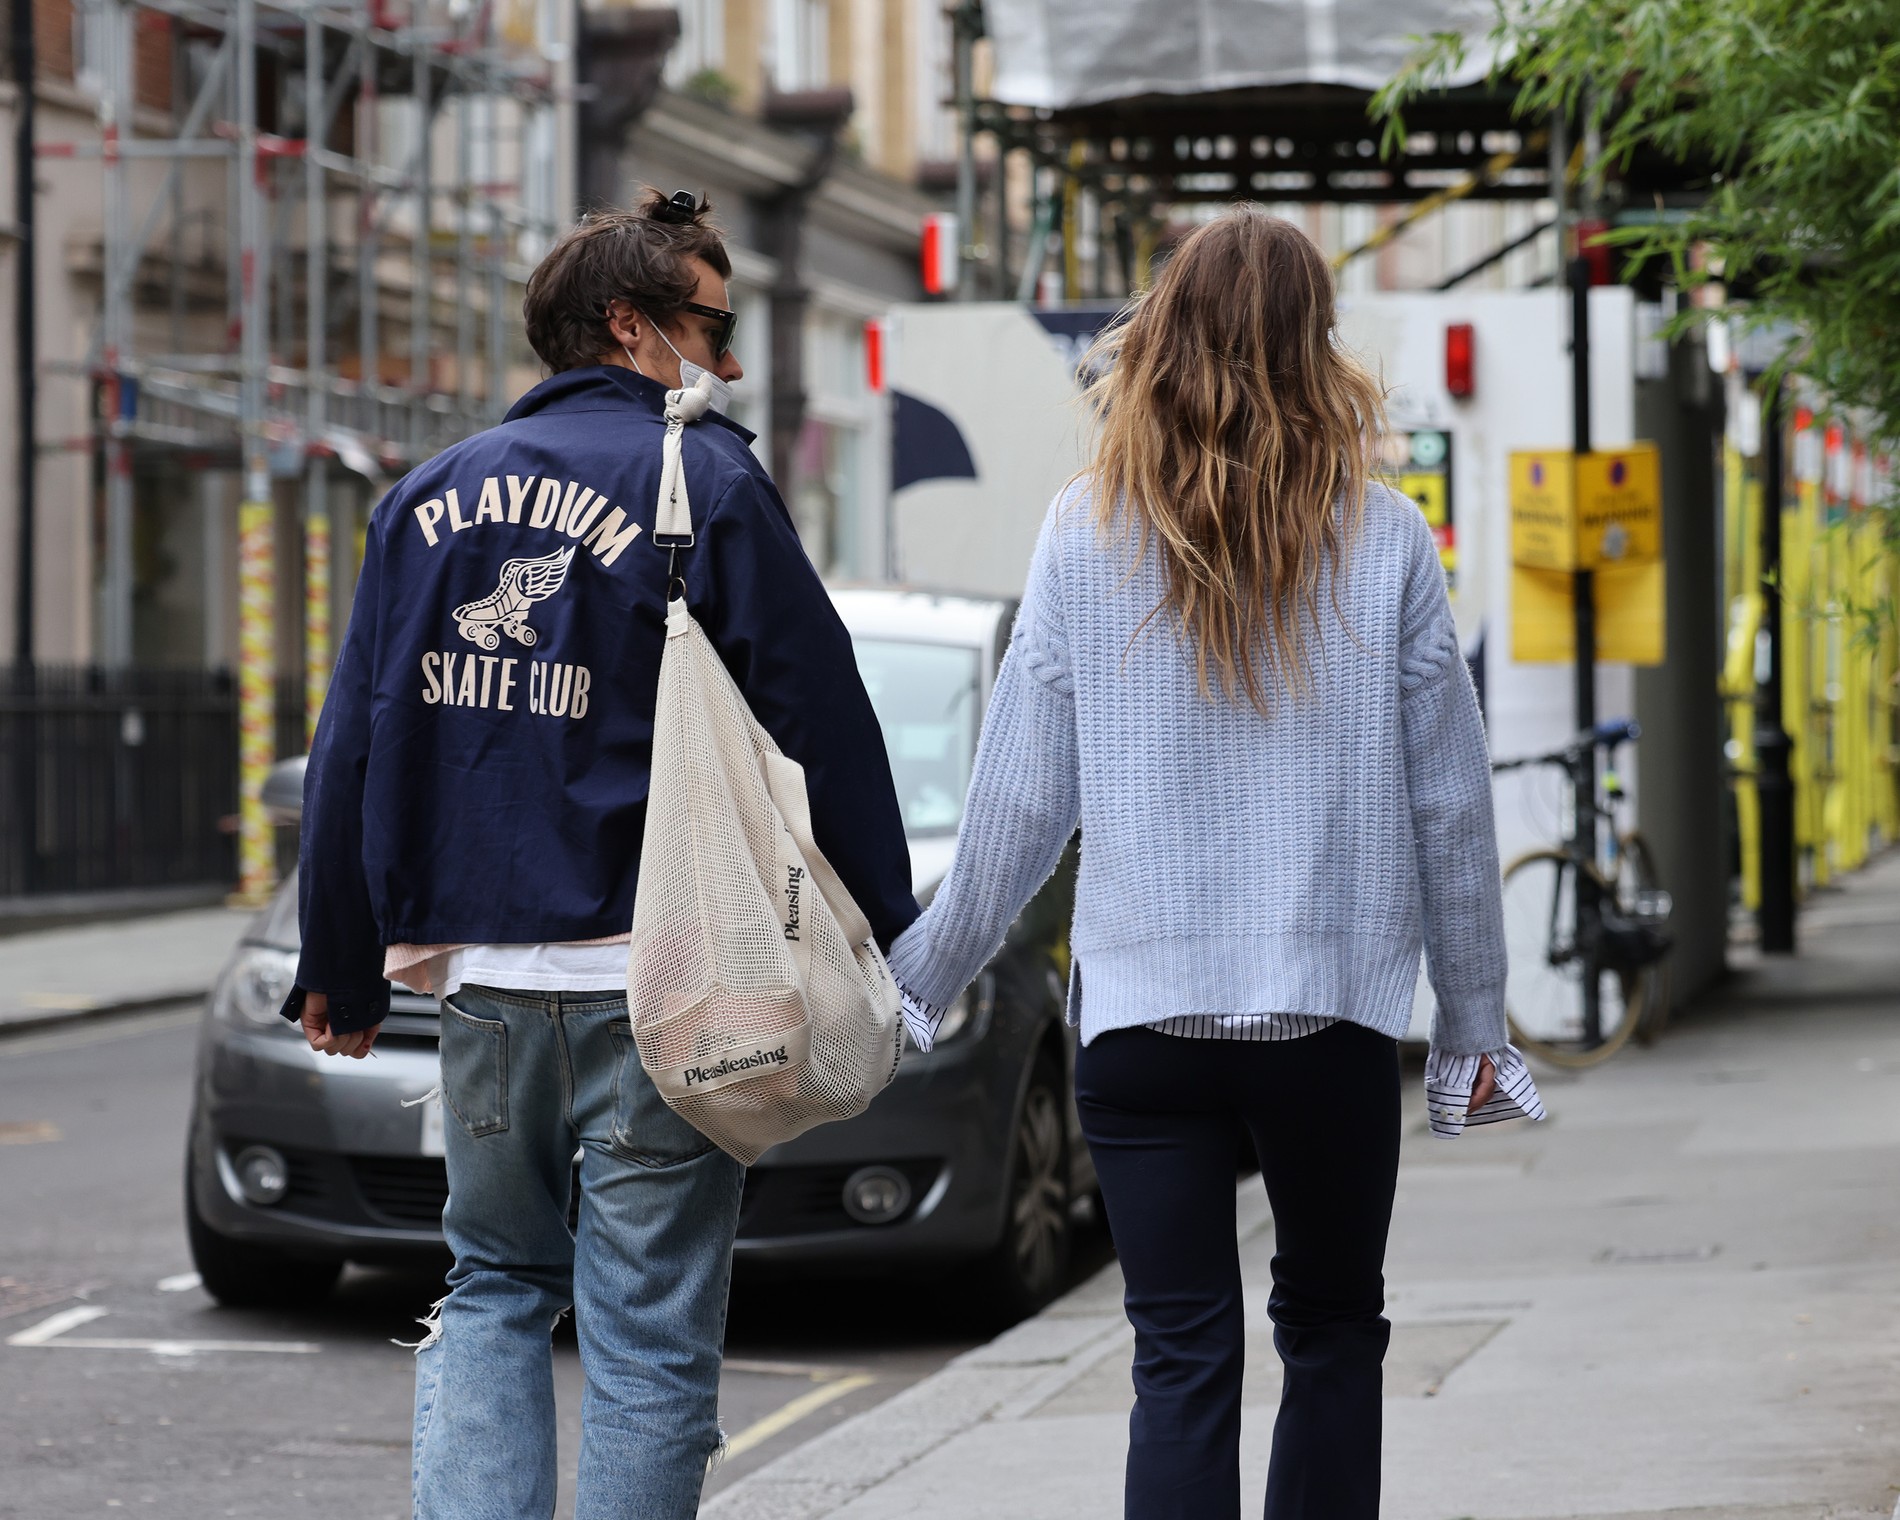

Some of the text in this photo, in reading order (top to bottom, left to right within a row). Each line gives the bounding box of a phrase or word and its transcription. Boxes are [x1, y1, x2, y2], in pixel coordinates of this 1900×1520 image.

[414, 475, 643, 567] PLAYDIUM
[421, 651, 591, 720] SKATE CLUB
[784, 864, 805, 942] Pleasing
